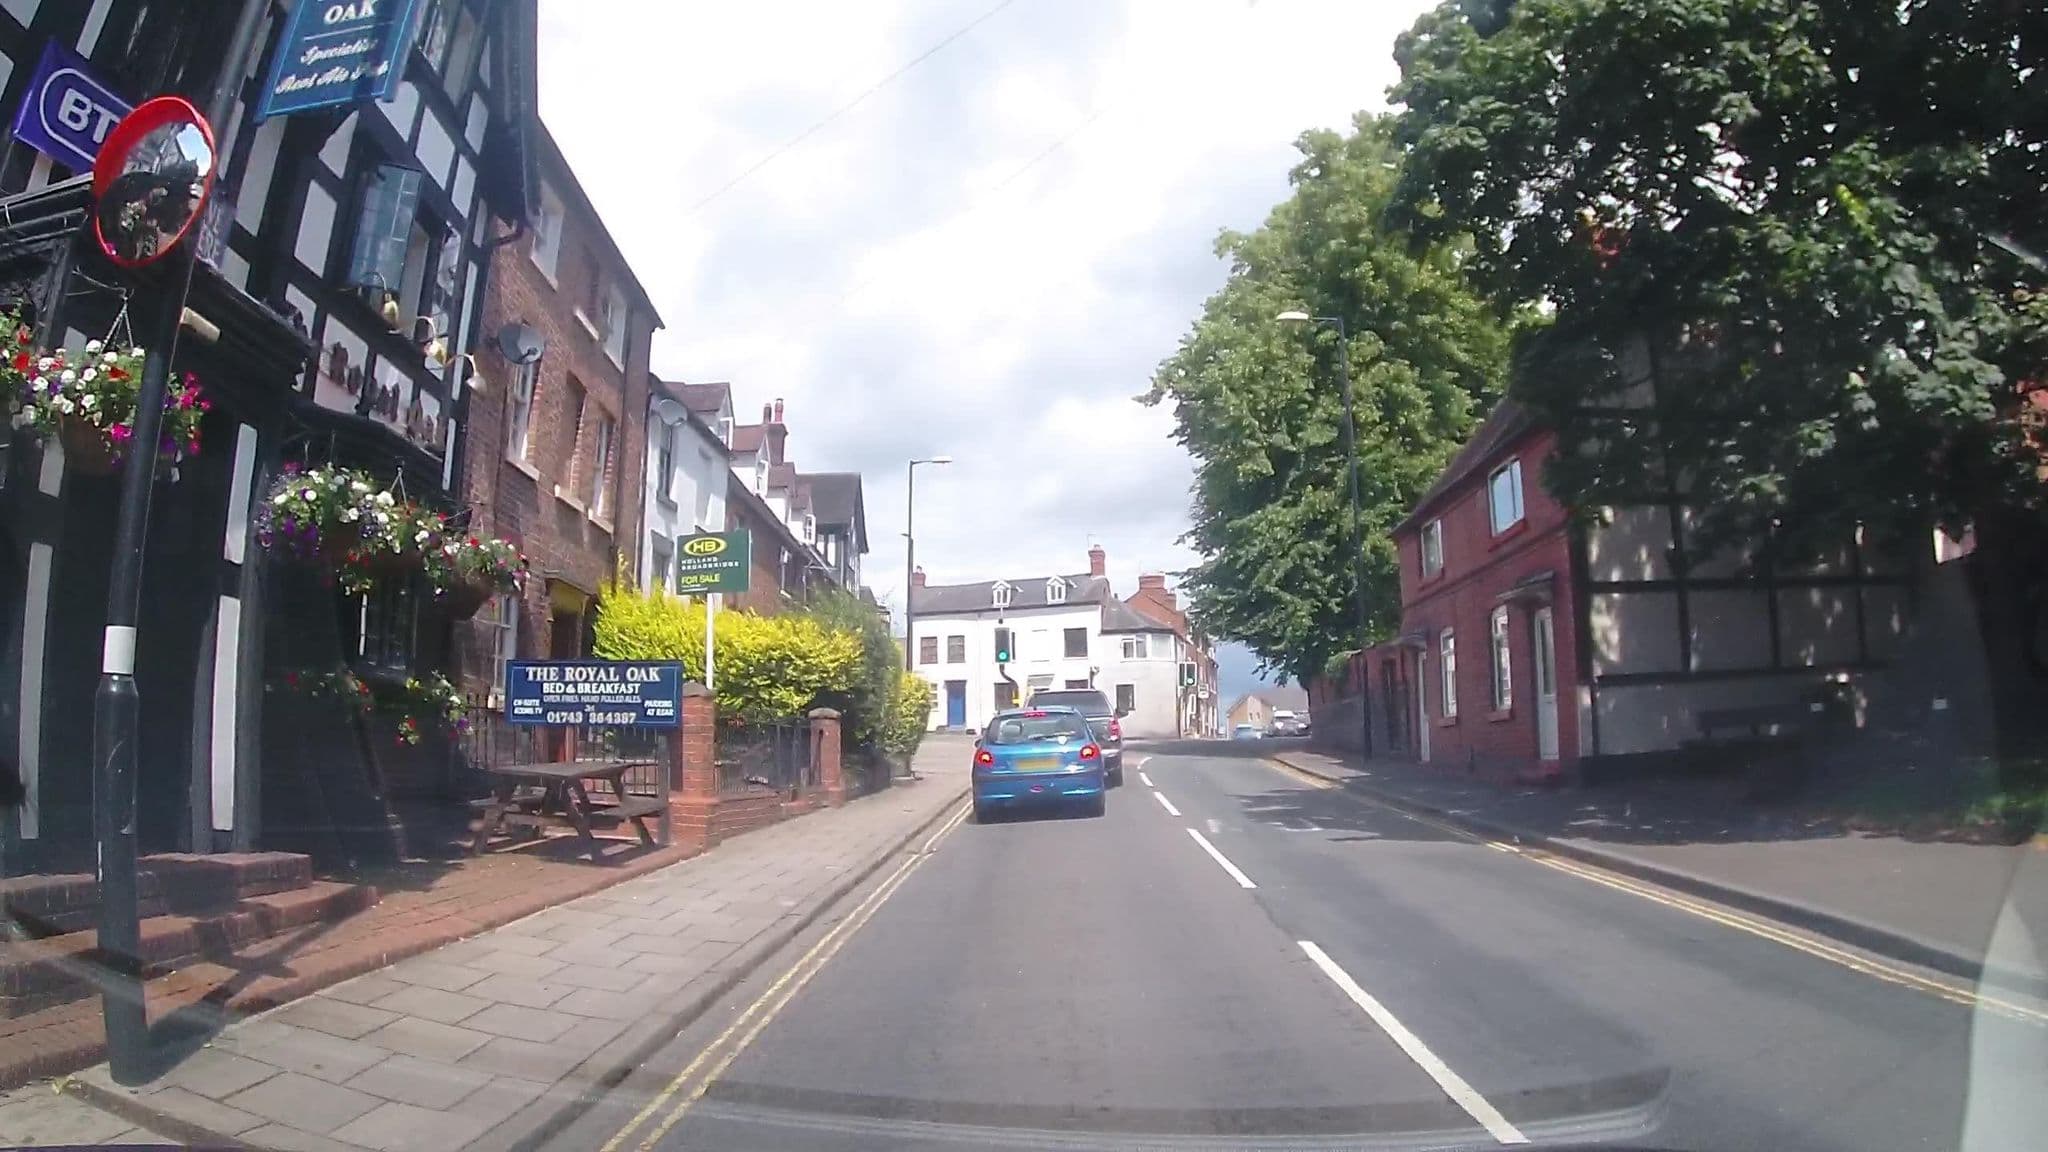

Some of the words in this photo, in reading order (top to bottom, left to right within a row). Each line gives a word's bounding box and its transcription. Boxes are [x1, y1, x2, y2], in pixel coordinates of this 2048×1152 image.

[323, 0, 376, 25] OAK
[58, 87, 121, 144] BT
[692, 541, 717, 553] HB
[681, 556, 718, 565] HOLLAND
[681, 575, 698, 585] FOR
[699, 573, 721, 584] SALE
[525, 666, 560, 682] THE
[564, 666, 620, 682] ROYAL
[626, 667, 661, 682] OAK
[542, 682, 566, 694] BED
[565, 683, 576, 694] &
[577, 682, 641, 694] BREAKFAST
[546, 711, 583, 724] 01743
[646, 708, 656, 716] AT
